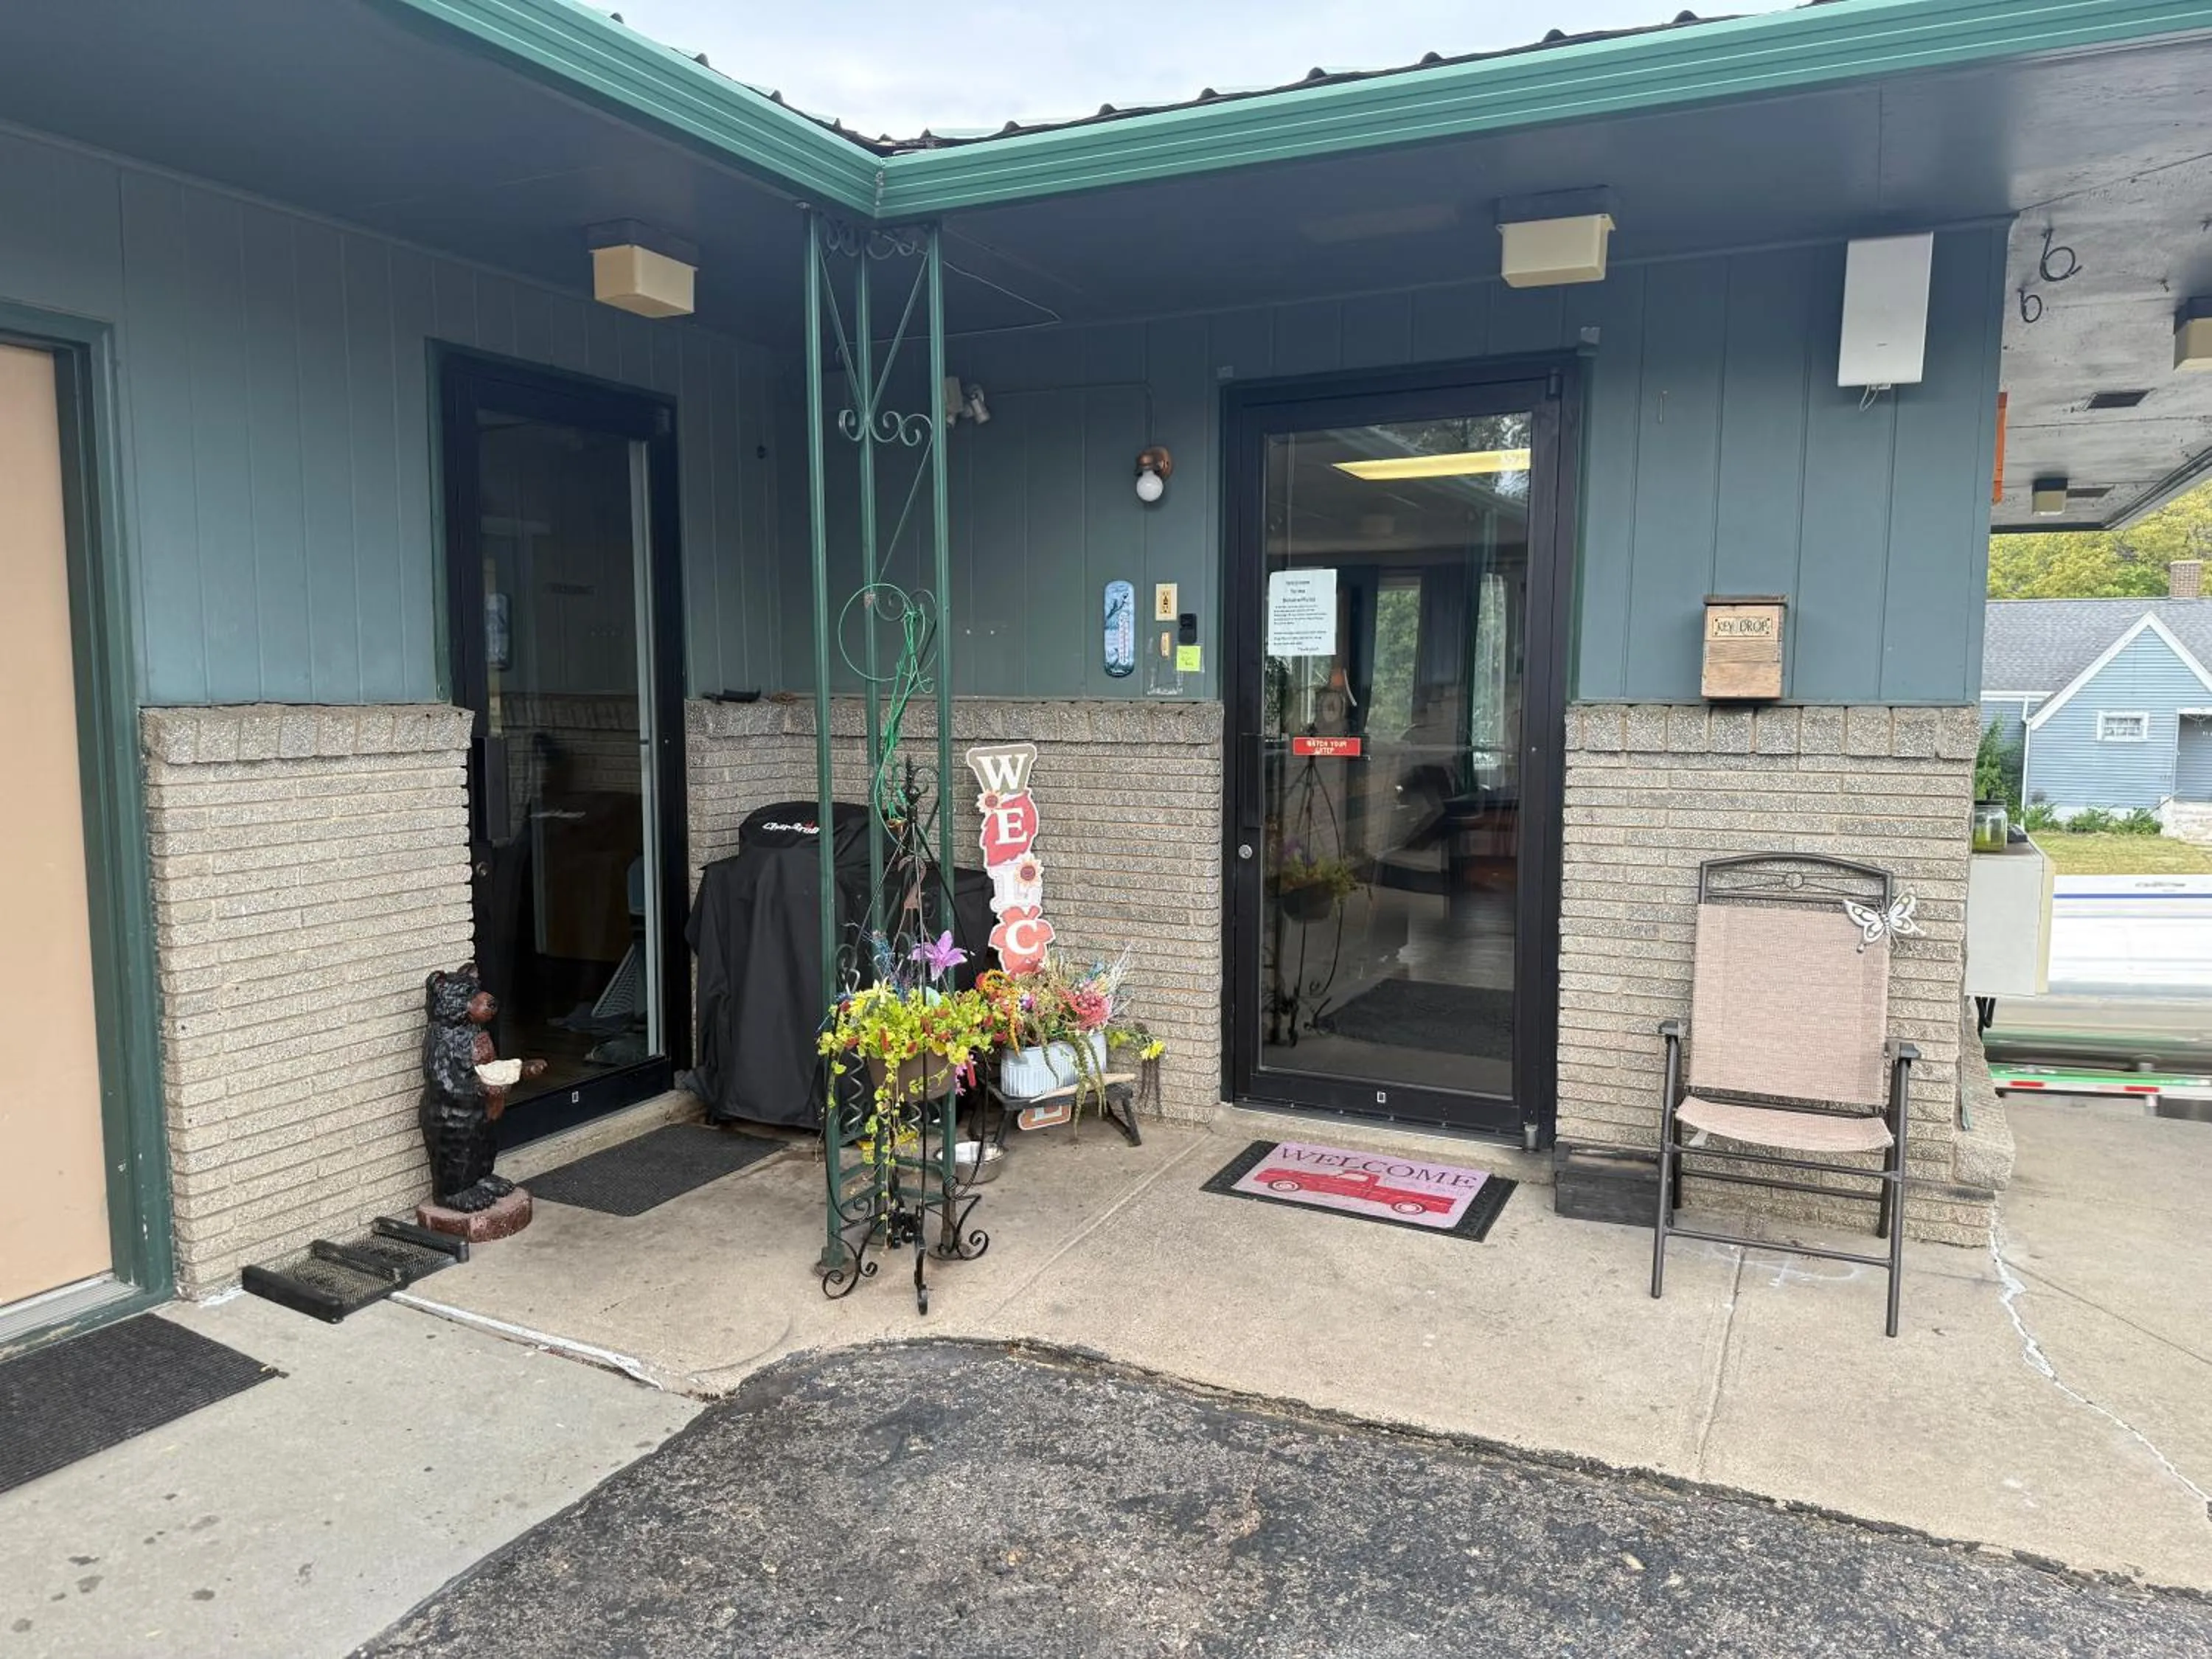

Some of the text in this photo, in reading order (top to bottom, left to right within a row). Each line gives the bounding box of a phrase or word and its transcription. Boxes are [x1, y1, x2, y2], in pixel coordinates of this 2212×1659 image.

[1717, 619, 1768, 633] KEY DROP
[1281, 1147, 1478, 1189] WELCOME
